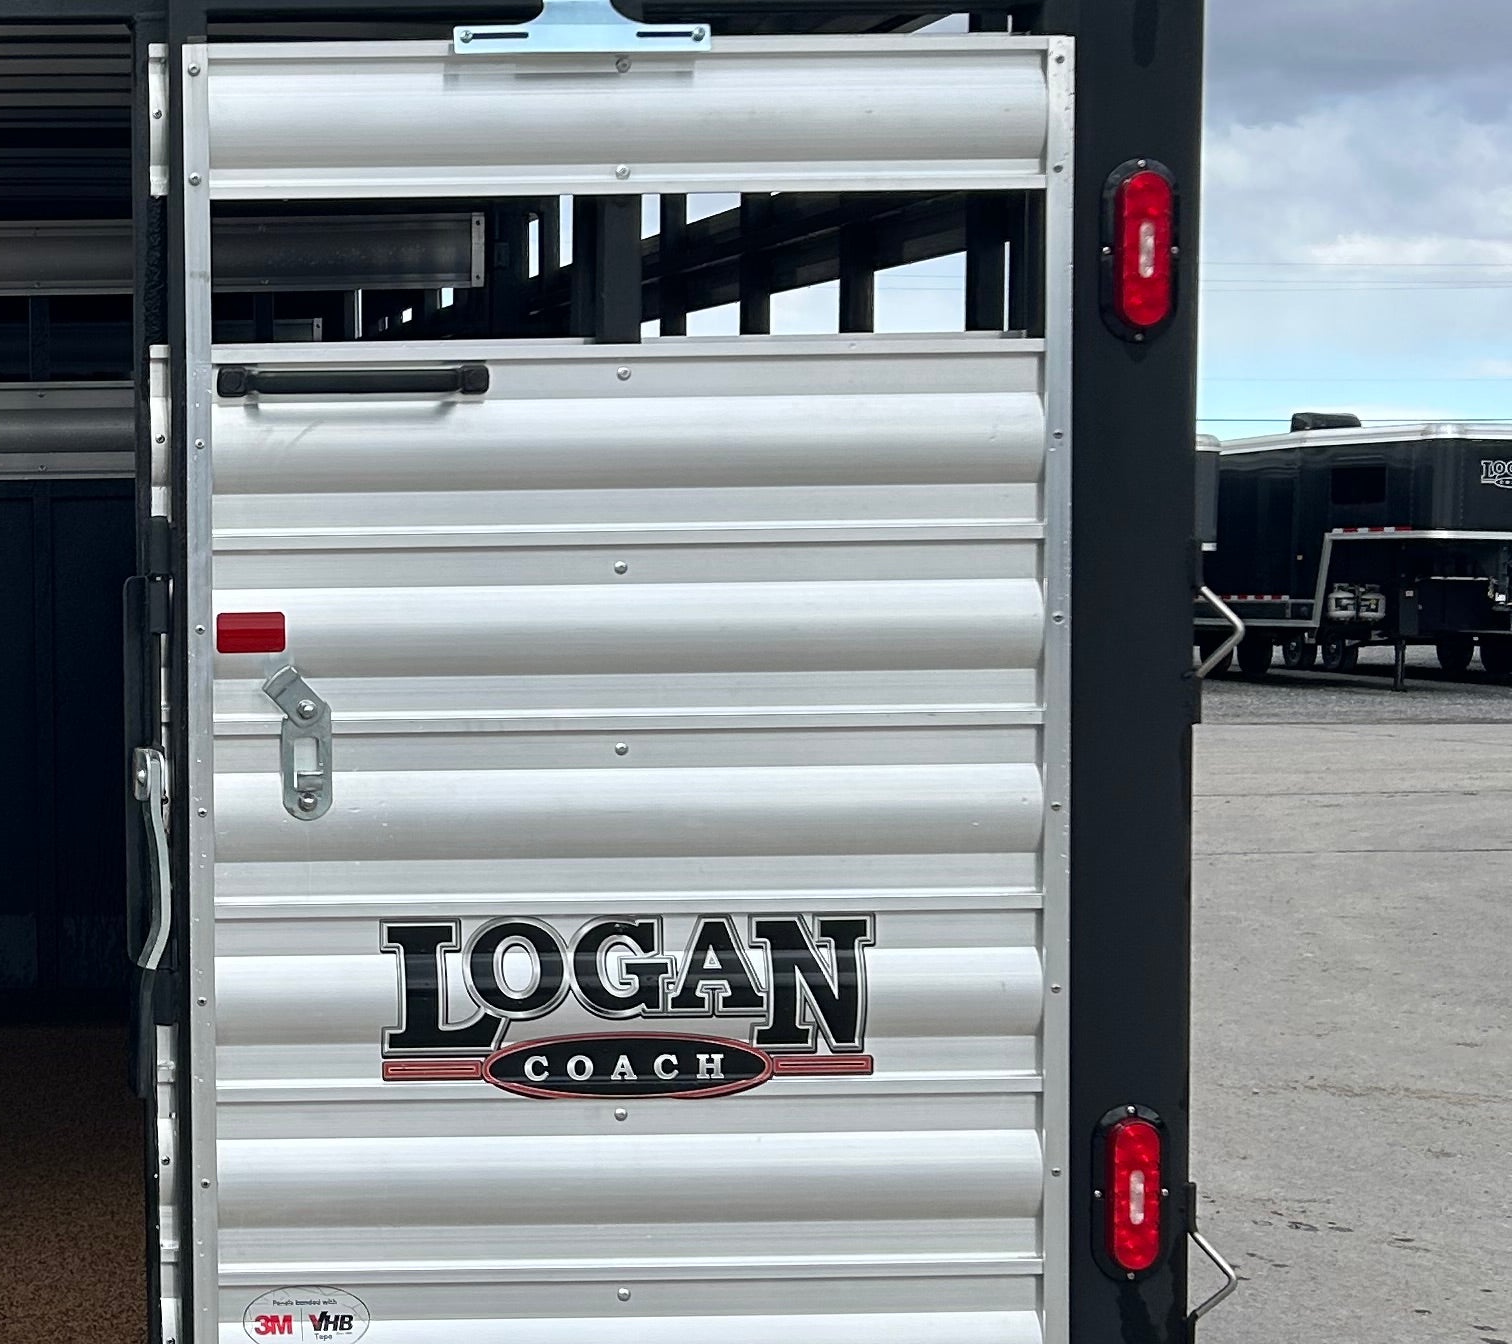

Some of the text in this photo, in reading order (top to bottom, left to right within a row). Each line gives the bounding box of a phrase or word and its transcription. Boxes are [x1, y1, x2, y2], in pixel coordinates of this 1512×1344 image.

[379, 912, 876, 1059] LOGAN
[523, 1053, 725, 1082] COACH
[254, 1314, 293, 1335] 3M
[308, 1310, 354, 1332] VHB
[314, 1333, 333, 1341] Tape
